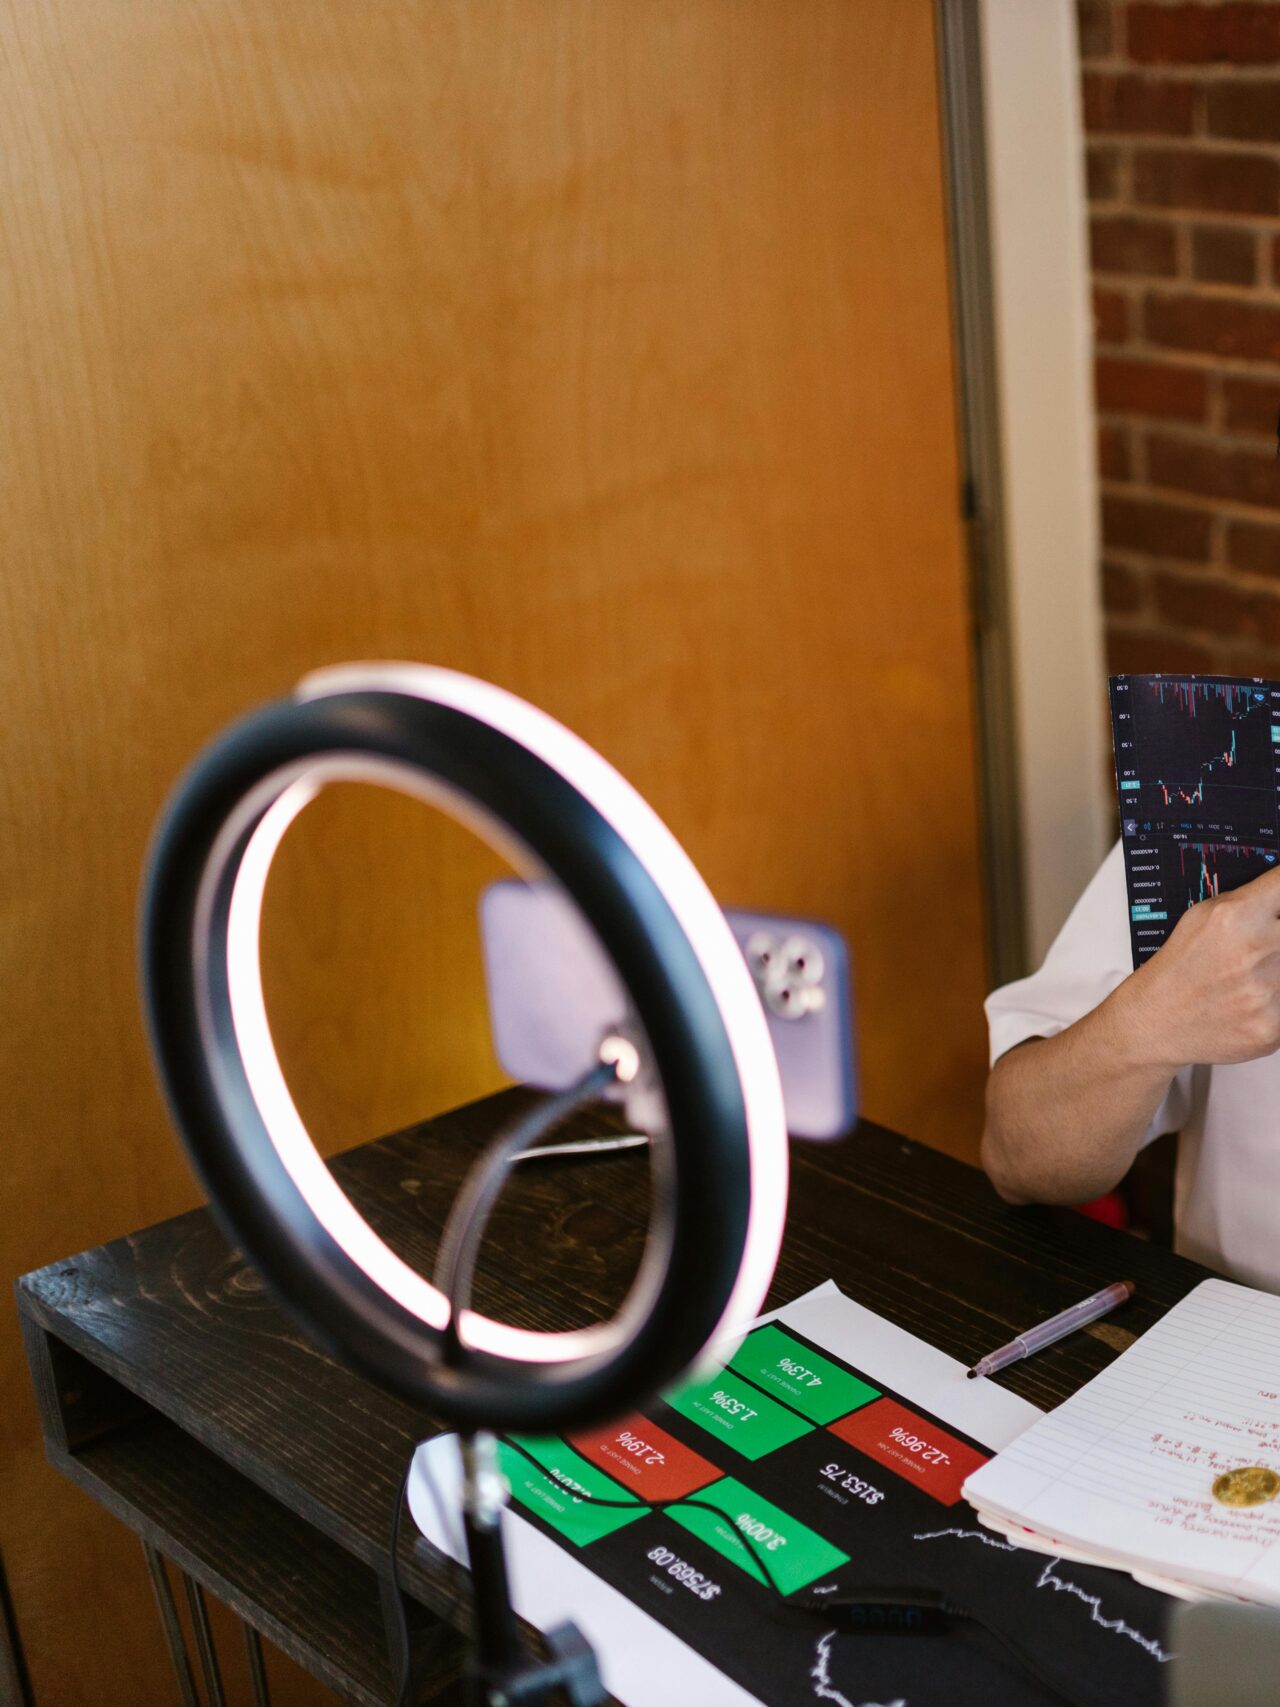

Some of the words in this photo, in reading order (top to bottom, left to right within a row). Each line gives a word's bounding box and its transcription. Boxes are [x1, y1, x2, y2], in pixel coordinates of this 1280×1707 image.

[776, 1358, 822, 1387] 4.13%
[709, 1391, 758, 1421] 1.53%
[615, 1431, 665, 1465] -2.19%
[889, 1427, 951, 1466] -12.96%
[819, 1463, 885, 1505] $153.75
[735, 1513, 787, 1551] 3.00%
[646, 1545, 722, 1600] $7569.08
